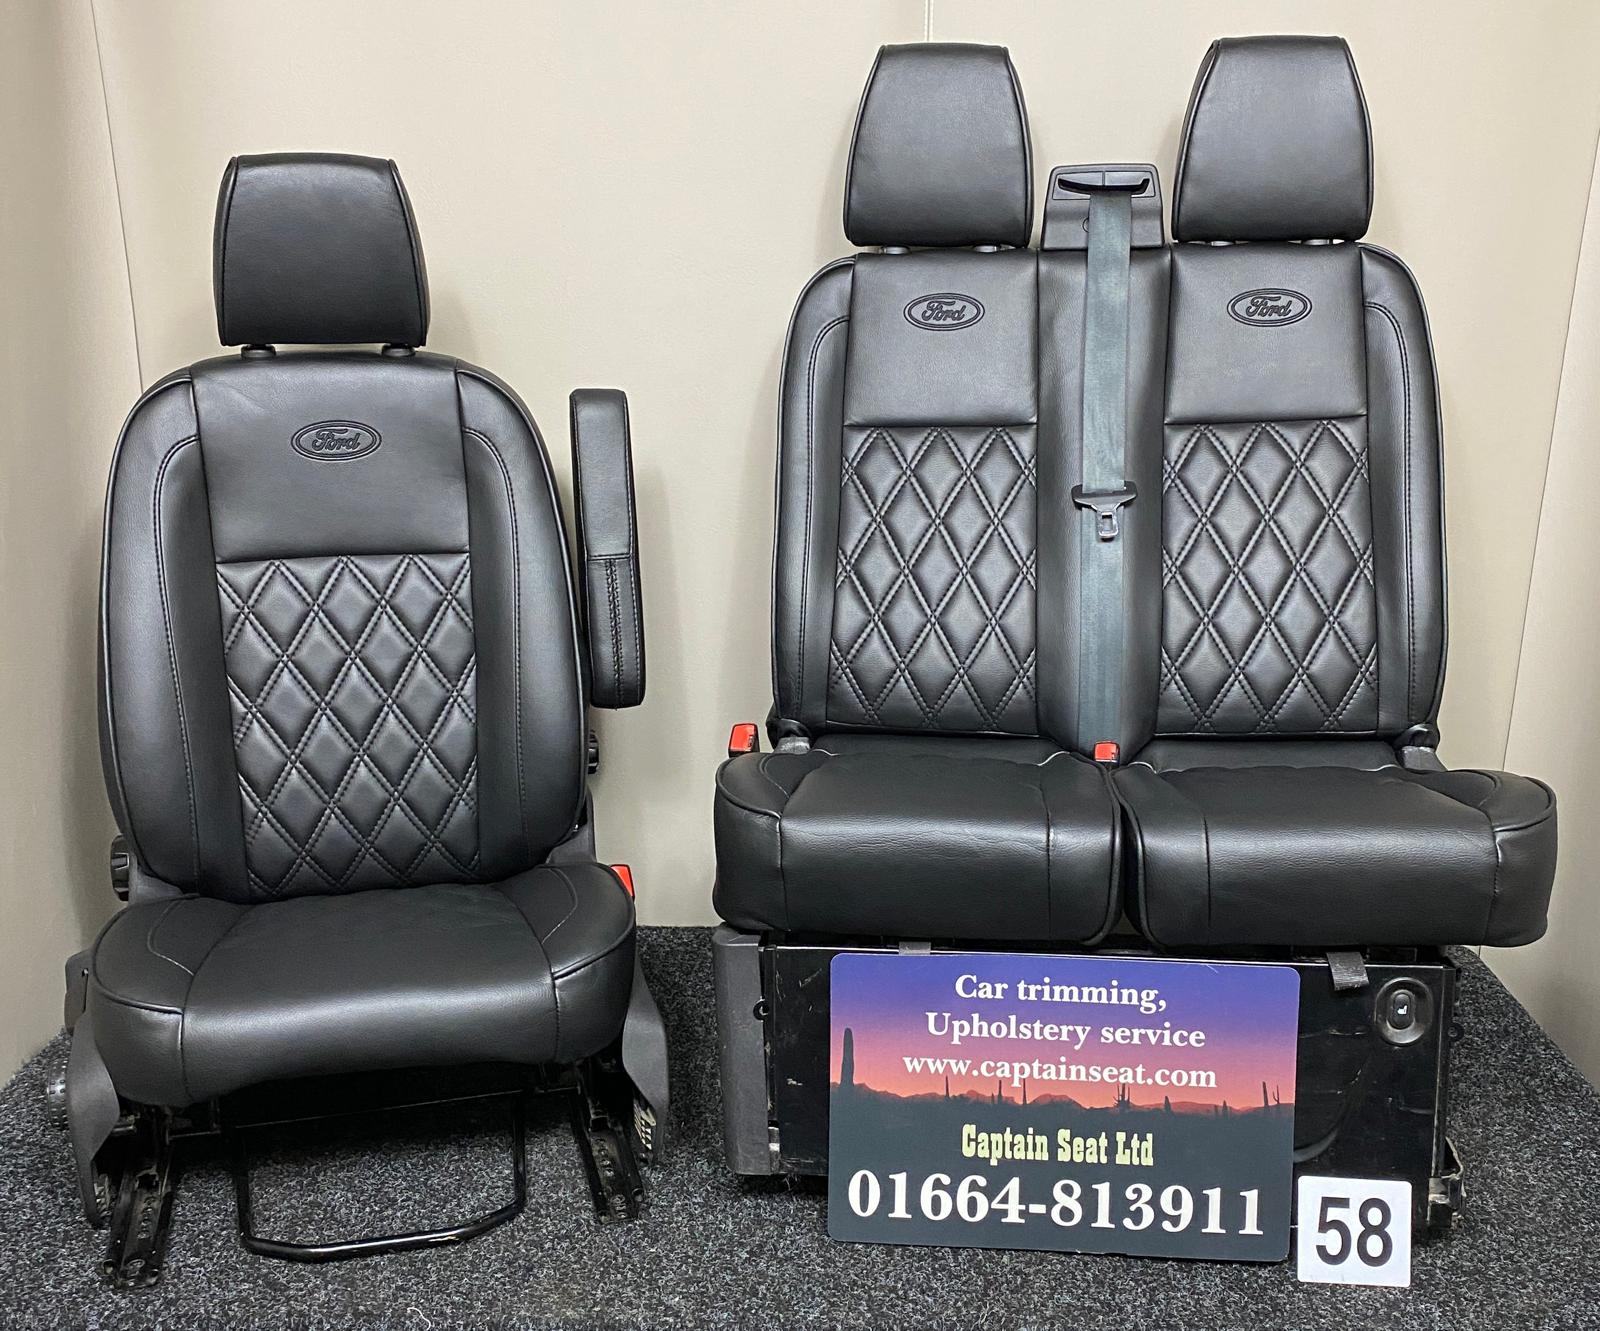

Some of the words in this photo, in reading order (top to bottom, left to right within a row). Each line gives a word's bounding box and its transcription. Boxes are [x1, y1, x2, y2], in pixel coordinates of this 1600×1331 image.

[921, 300, 967, 322] Ford
[1246, 296, 1291, 318] Ford
[312, 428, 361, 452] Ford
[954, 974, 1008, 1001] Car
[1017, 977, 1167, 1013] trimming,
[925, 1011, 1091, 1051] Upholstery
[1100, 1022, 1206, 1048] service
[903, 1055, 1217, 1089] www.captainseat.com
[961, 1124, 1049, 1167] Captain
[1057, 1128, 1108, 1164] Seat
[1116, 1132, 1154, 1167] Ltd
[848, 1169, 1264, 1236] 01664-813911
[1316, 1196, 1393, 1266] 58
